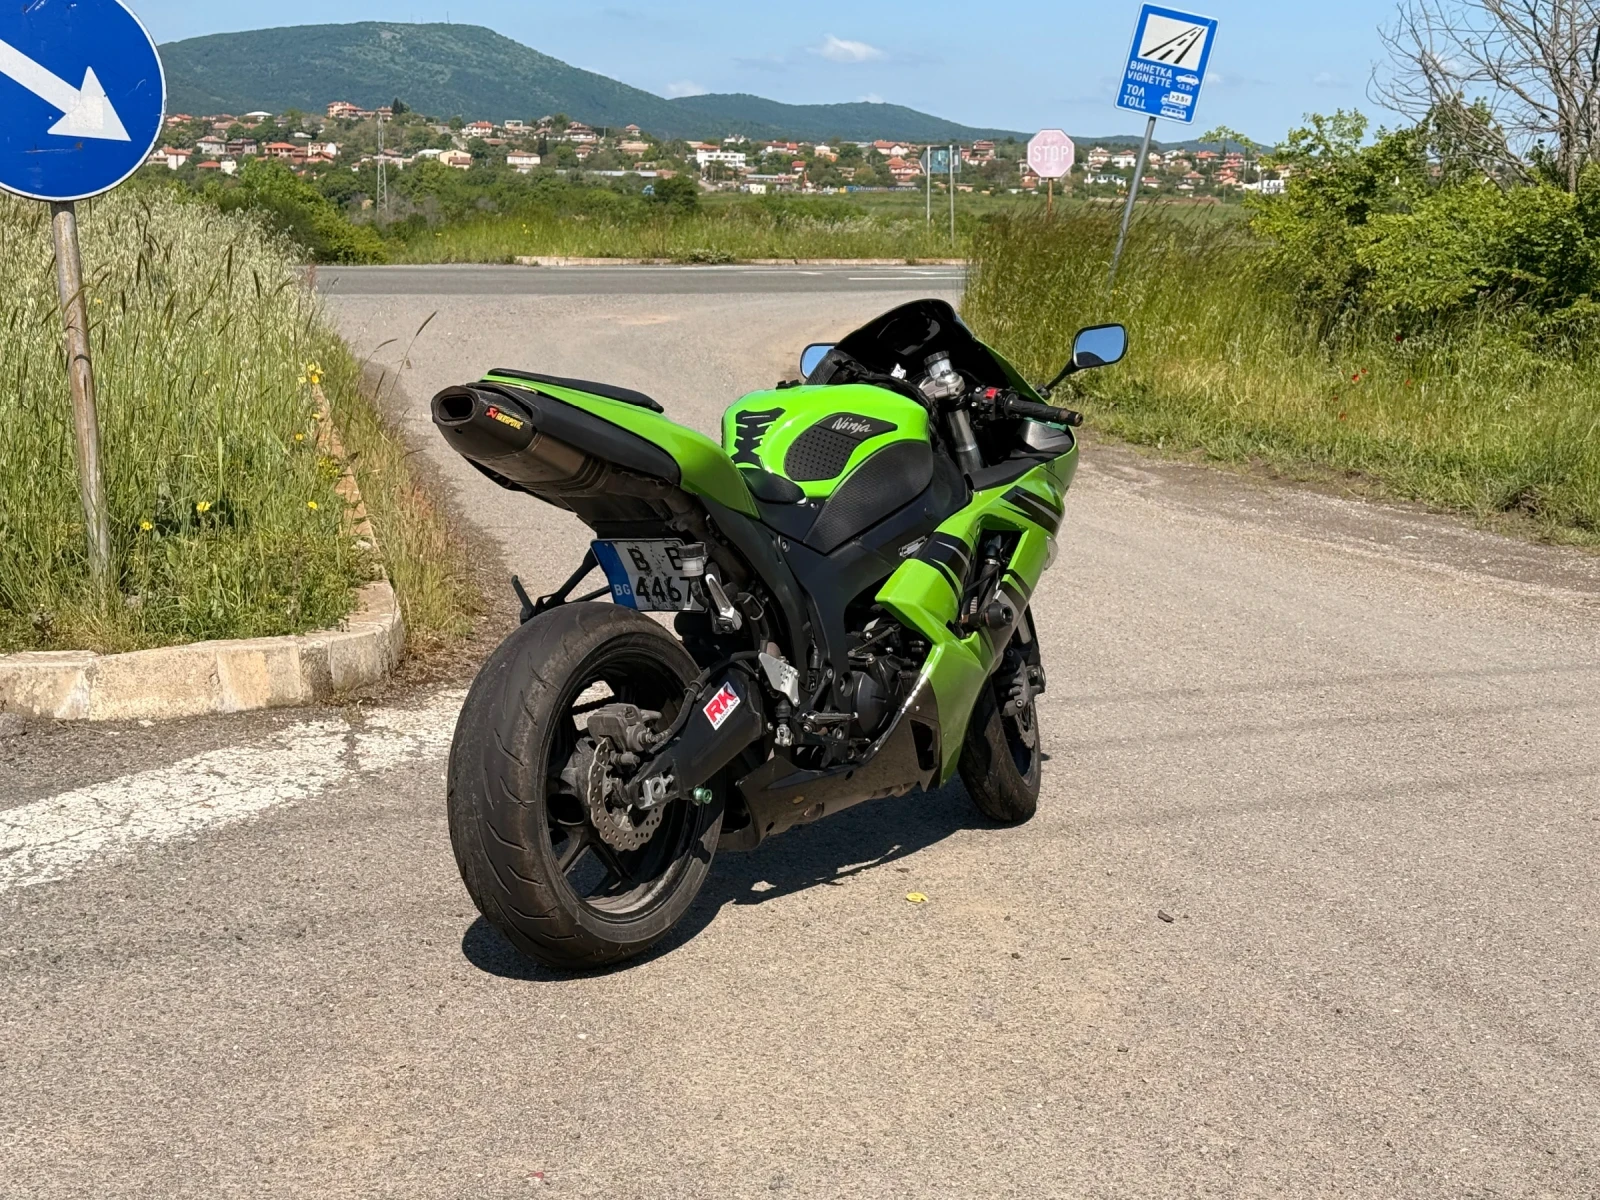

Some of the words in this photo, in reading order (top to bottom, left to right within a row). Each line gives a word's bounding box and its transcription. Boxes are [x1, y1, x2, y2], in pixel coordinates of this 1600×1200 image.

[1130, 60, 1172, 78] ВИНЕТКА
[1127, 70, 1172, 88] VIGNETTE
[1126, 84, 1145, 97] ТОЛ
[1123, 95, 1146, 109] TOLL
[1033, 145, 1069, 162] STOP
[831, 416, 872, 434] Ninja
[627, 548, 650, 570] B
[614, 584, 631, 596] BG
[636, 576, 691, 603] 4467
[706, 688, 737, 723] RK
